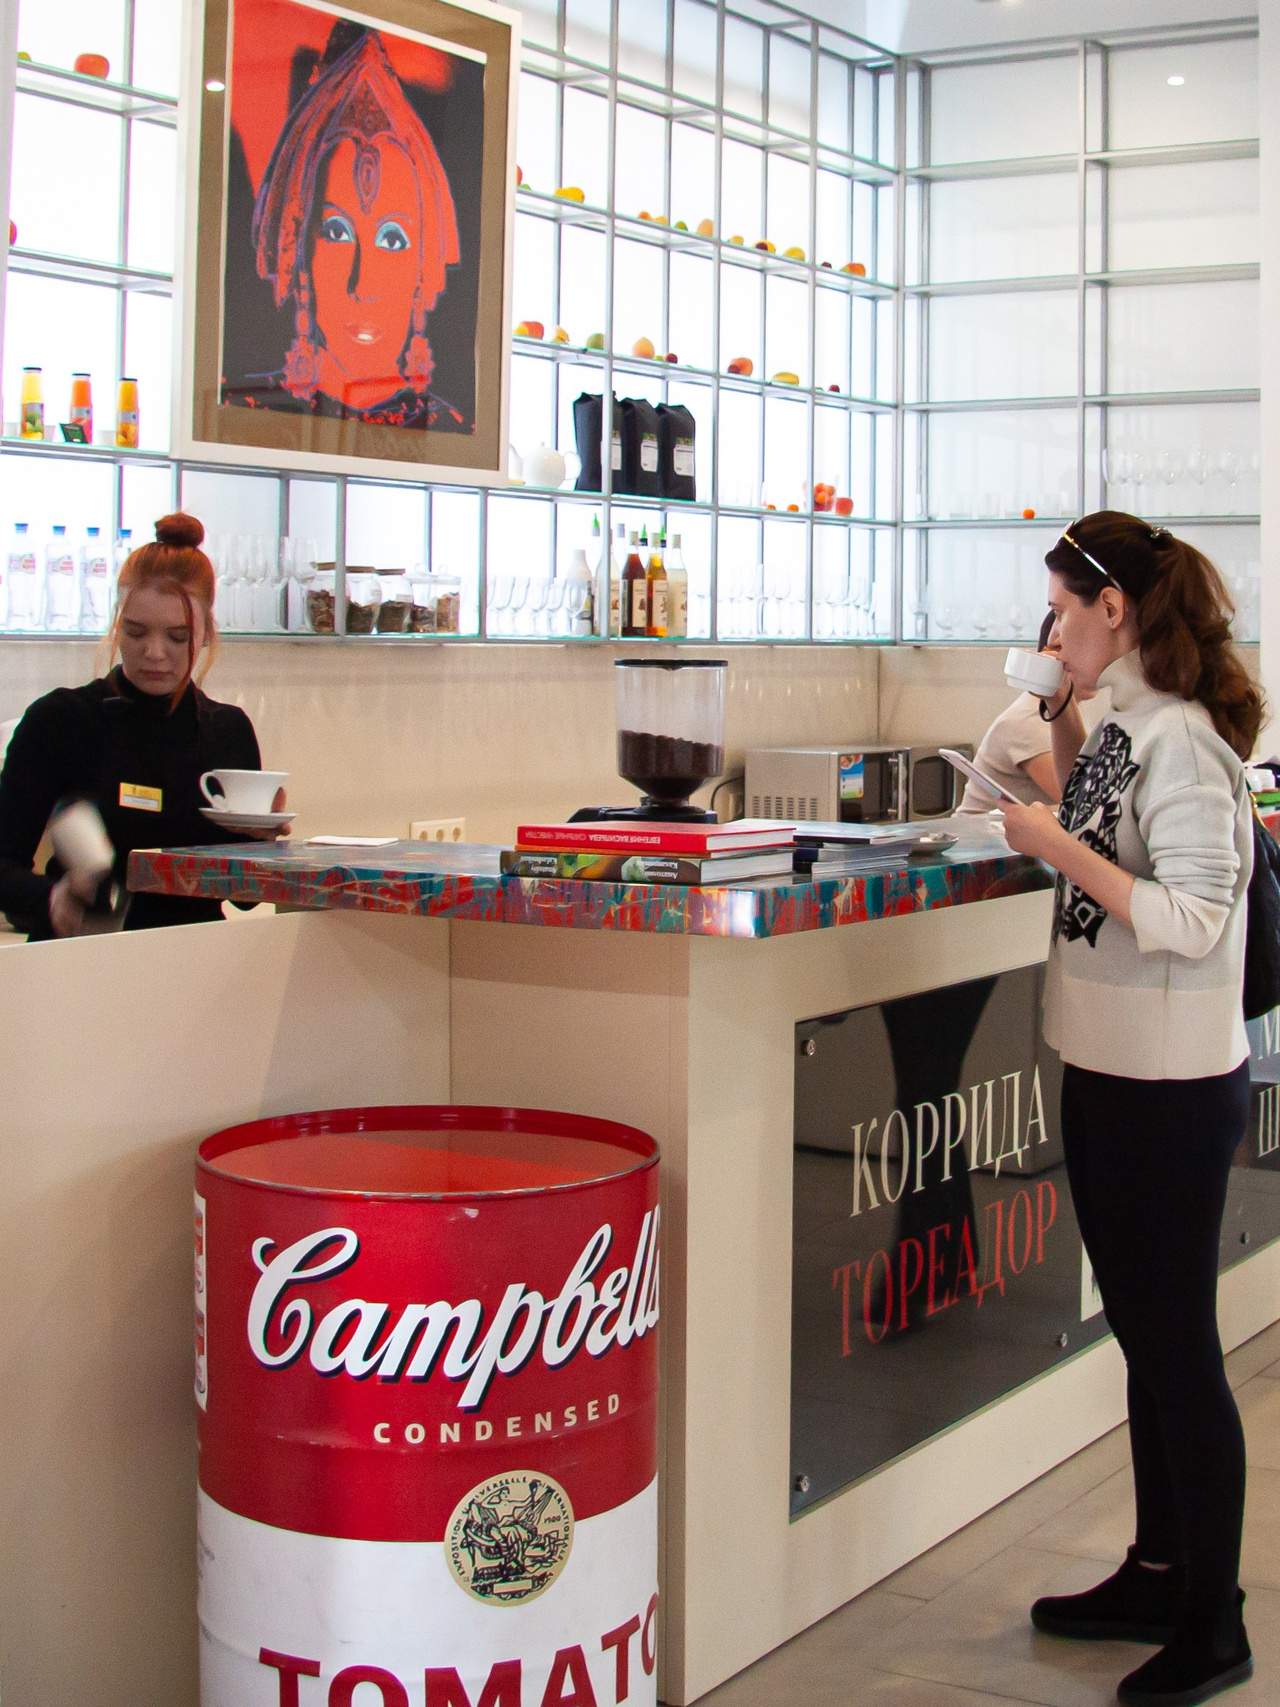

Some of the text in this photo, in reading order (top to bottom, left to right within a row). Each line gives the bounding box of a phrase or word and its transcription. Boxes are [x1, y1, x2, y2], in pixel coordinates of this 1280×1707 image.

[850, 1064, 1048, 1217] КОРРИДА
[833, 1180, 1058, 1357] ТОРЕАДОР
[373, 1393, 621, 1444] CONDENSED
